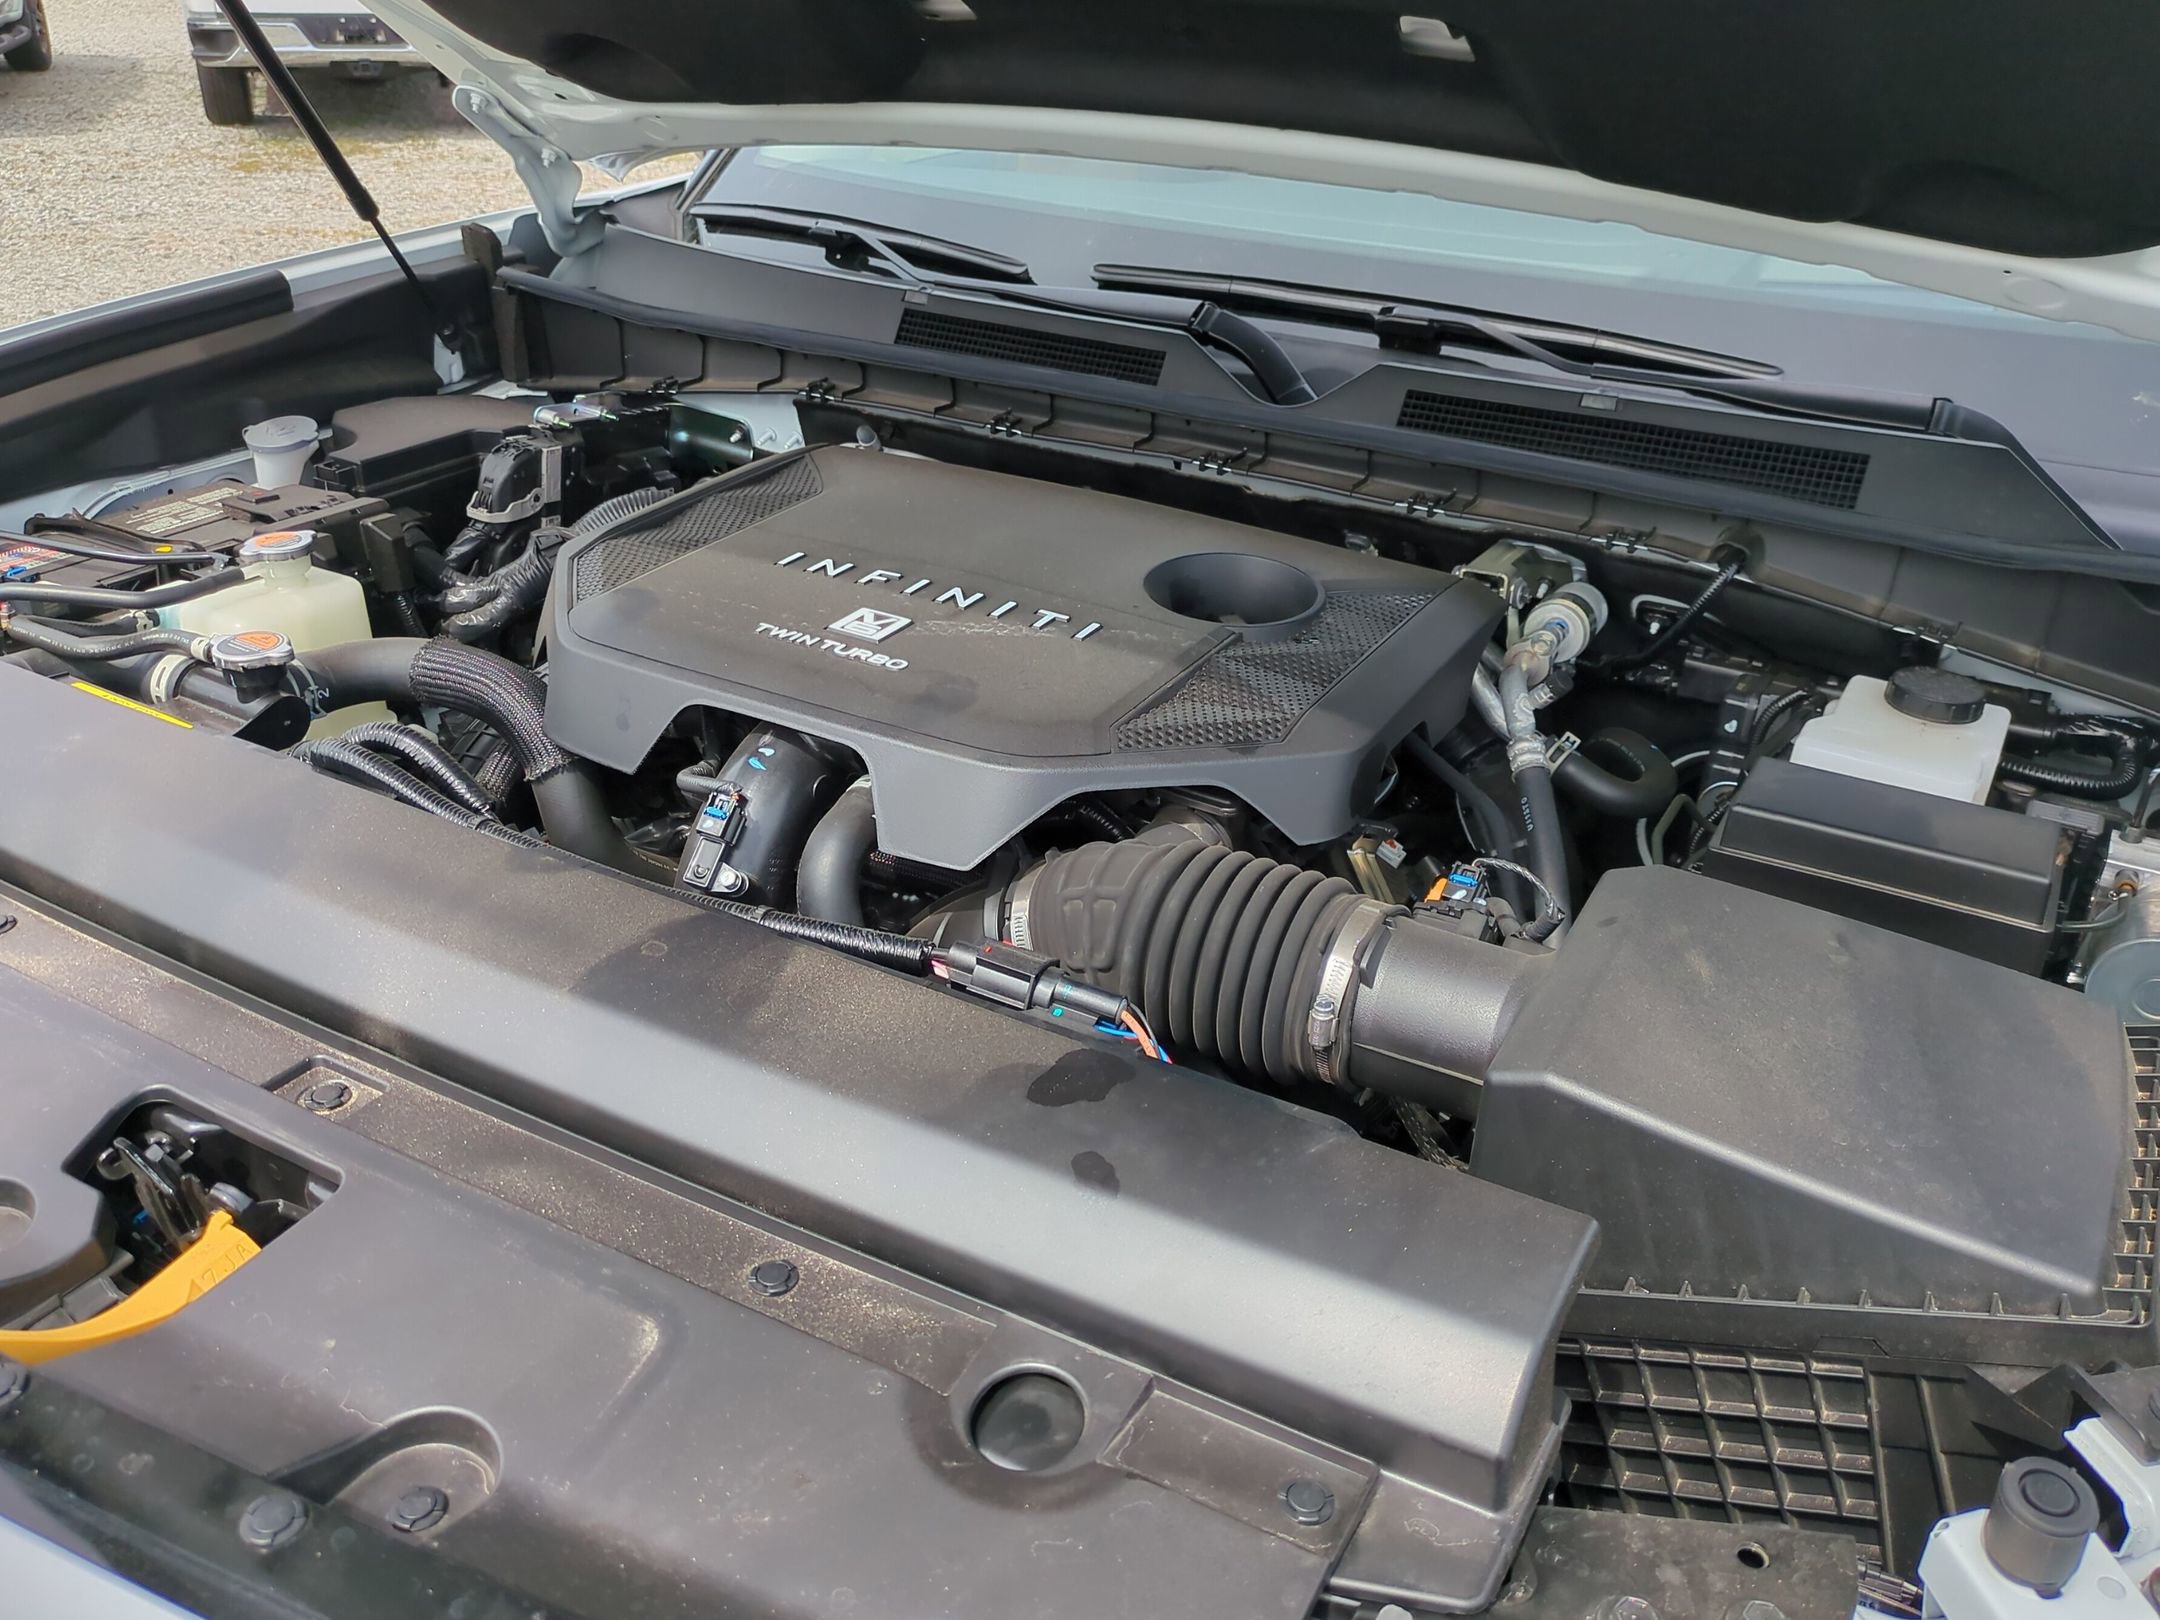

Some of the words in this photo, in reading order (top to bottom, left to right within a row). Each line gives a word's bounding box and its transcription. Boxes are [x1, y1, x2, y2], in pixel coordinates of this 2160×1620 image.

[775, 552, 1102, 641] INFINITI
[755, 621, 821, 647] TWIN
[820, 639, 909, 671] TURBO
[317, 687, 330, 699] 2
